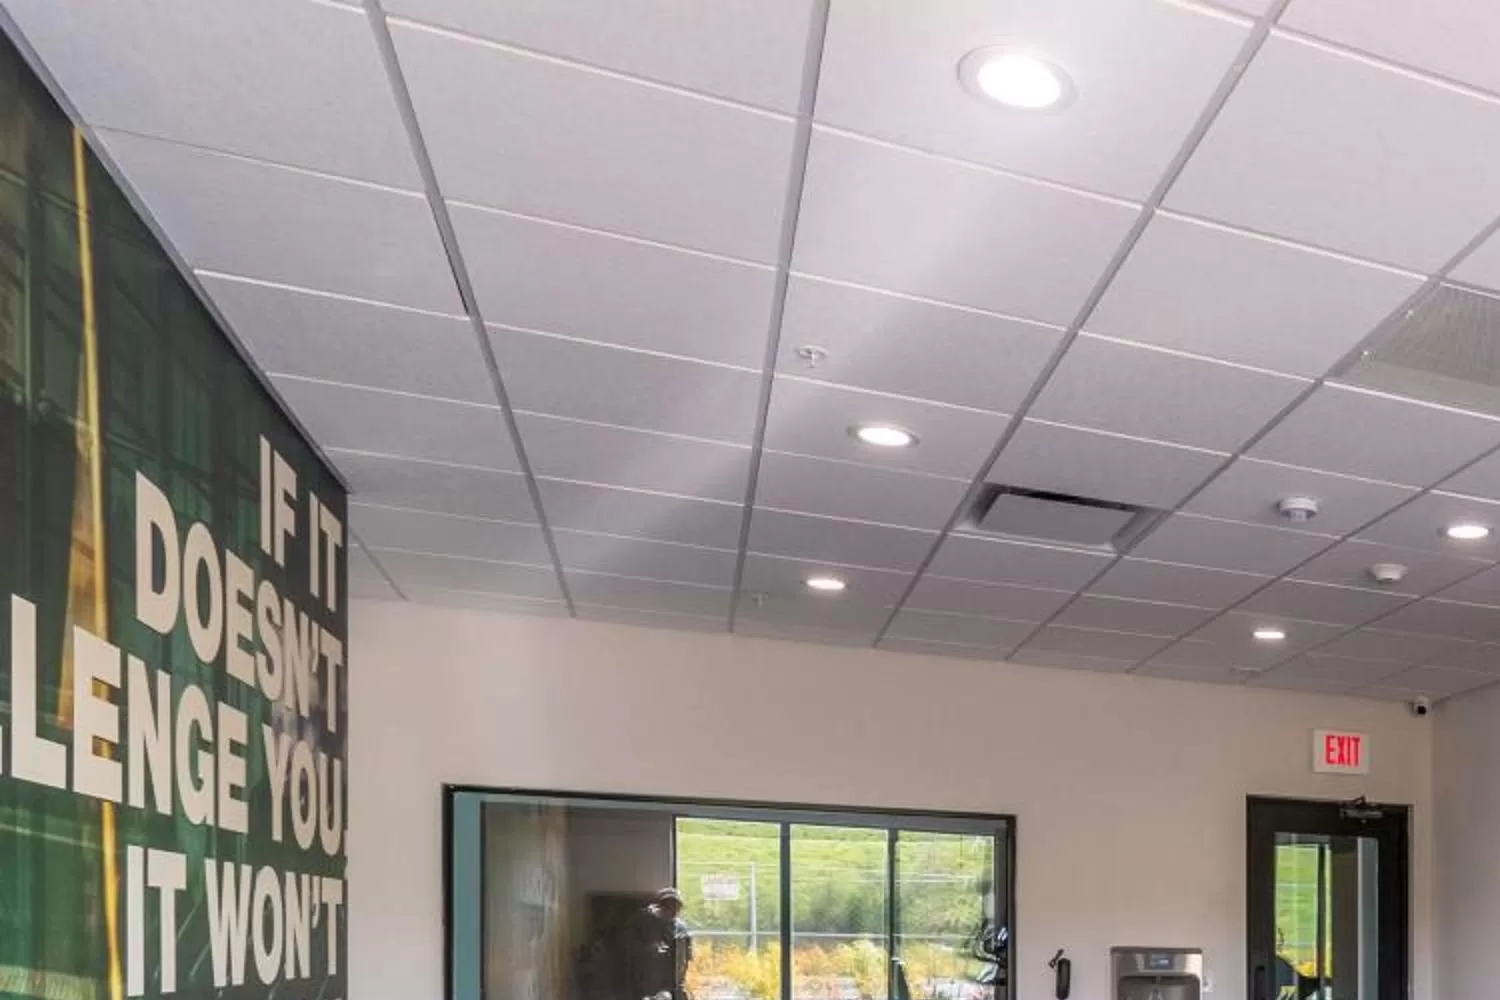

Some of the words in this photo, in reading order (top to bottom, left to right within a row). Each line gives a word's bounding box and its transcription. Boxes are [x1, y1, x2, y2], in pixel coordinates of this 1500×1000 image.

[135, 470, 343, 734] DOESN'T
[259, 434, 297, 568] IF
[309, 491, 343, 613] IT
[0, 593, 249, 834] LENGE
[1325, 734, 1360, 767] EXIT
[127, 844, 187, 997] IT
[204, 858, 343, 988] WON'T
